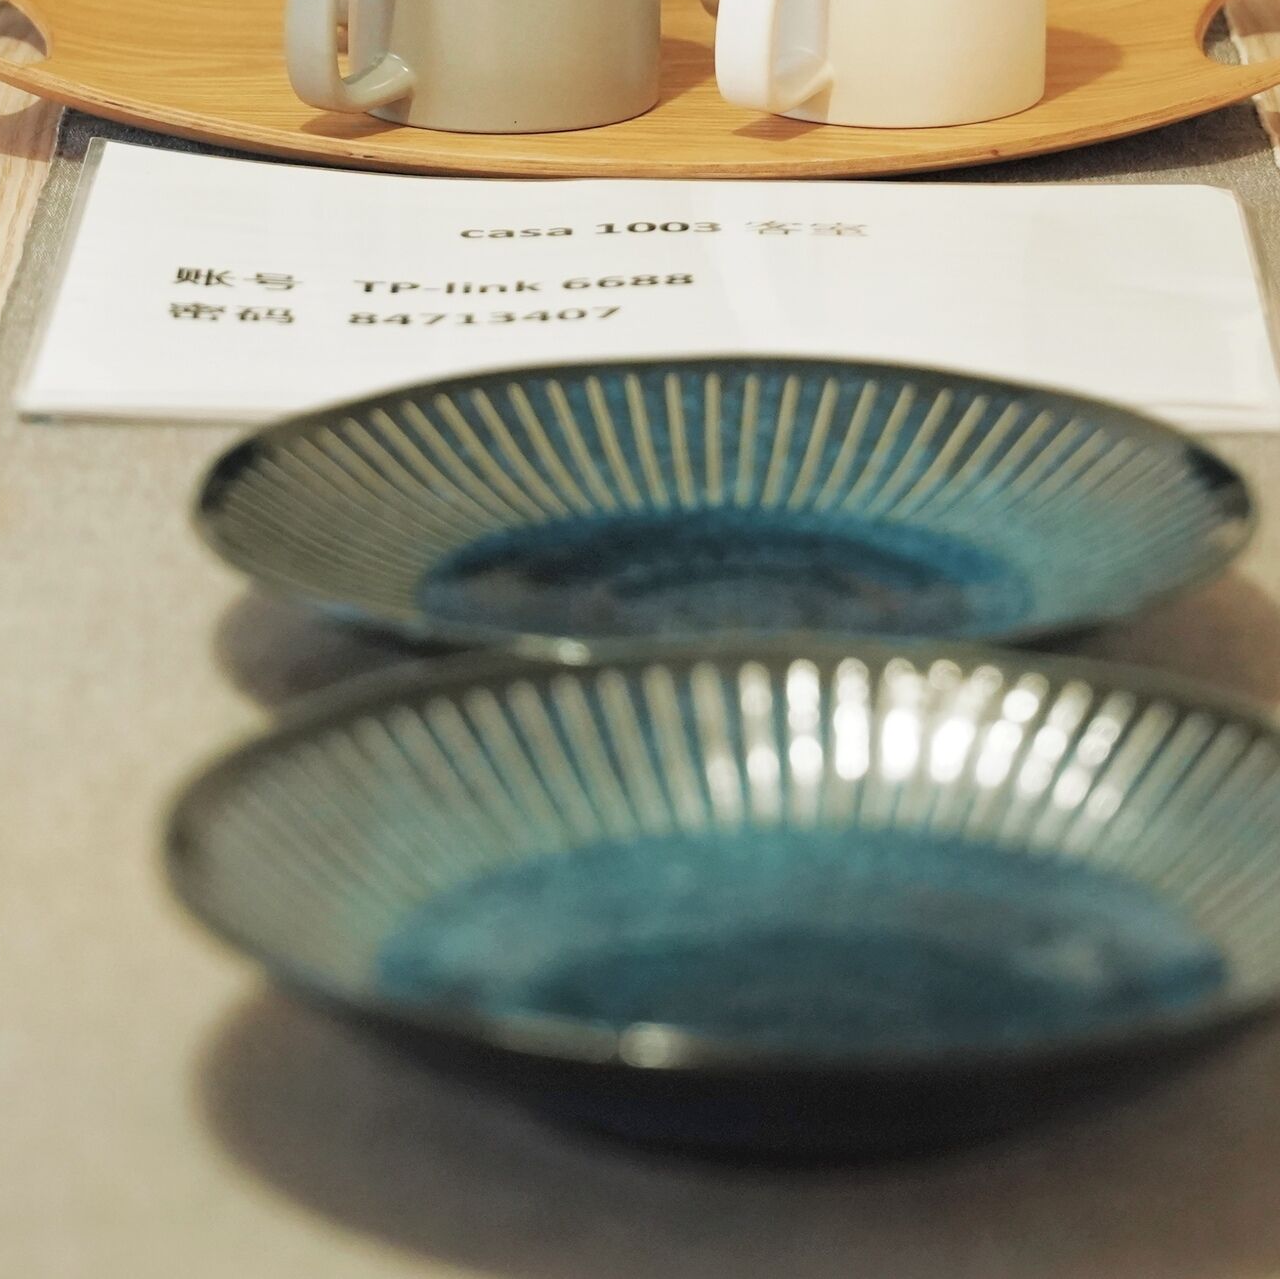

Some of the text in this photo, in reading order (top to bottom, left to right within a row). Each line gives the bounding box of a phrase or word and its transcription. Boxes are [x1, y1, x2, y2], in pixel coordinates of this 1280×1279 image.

[459, 225, 574, 240] casa
[593, 220, 722, 236] 1003
[172, 266, 695, 295] 账号 TP-link 6688
[168, 300, 622, 326] 密码 84713407
